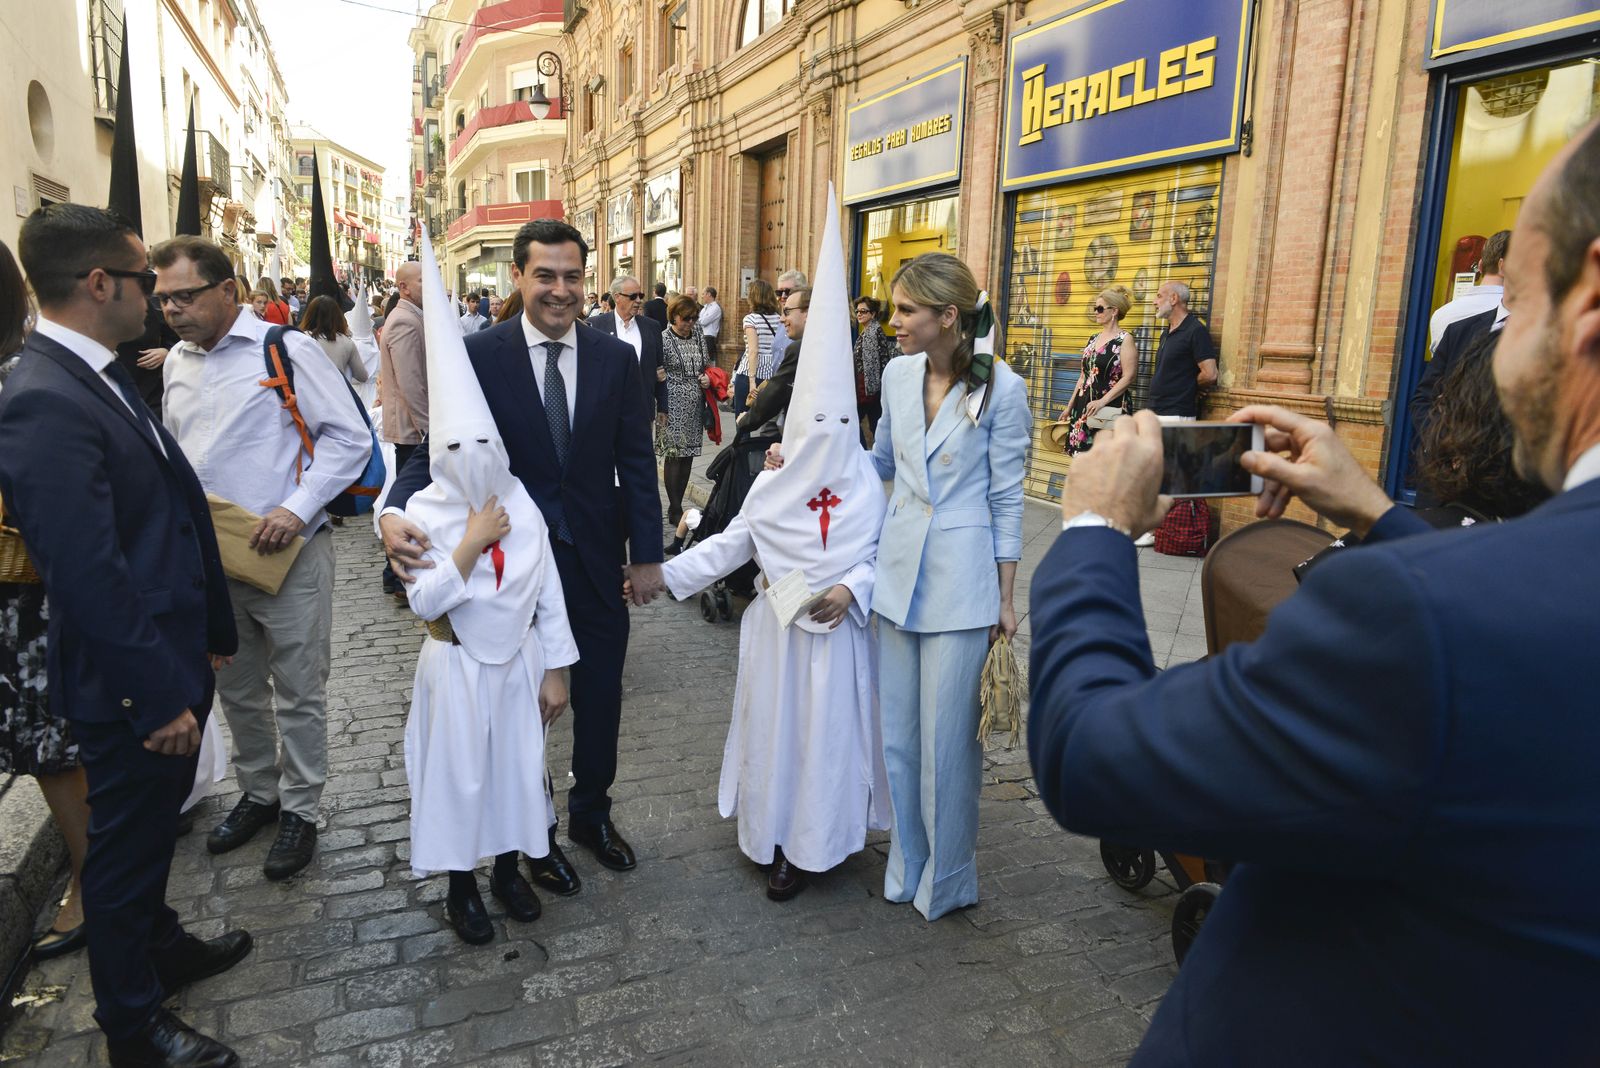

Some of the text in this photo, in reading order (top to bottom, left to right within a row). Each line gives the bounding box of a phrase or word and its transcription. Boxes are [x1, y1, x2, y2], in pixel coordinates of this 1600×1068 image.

[1018, 35, 1217, 147] HERACLES
[850, 113, 952, 161] REGALOS PARA HOMBRES
